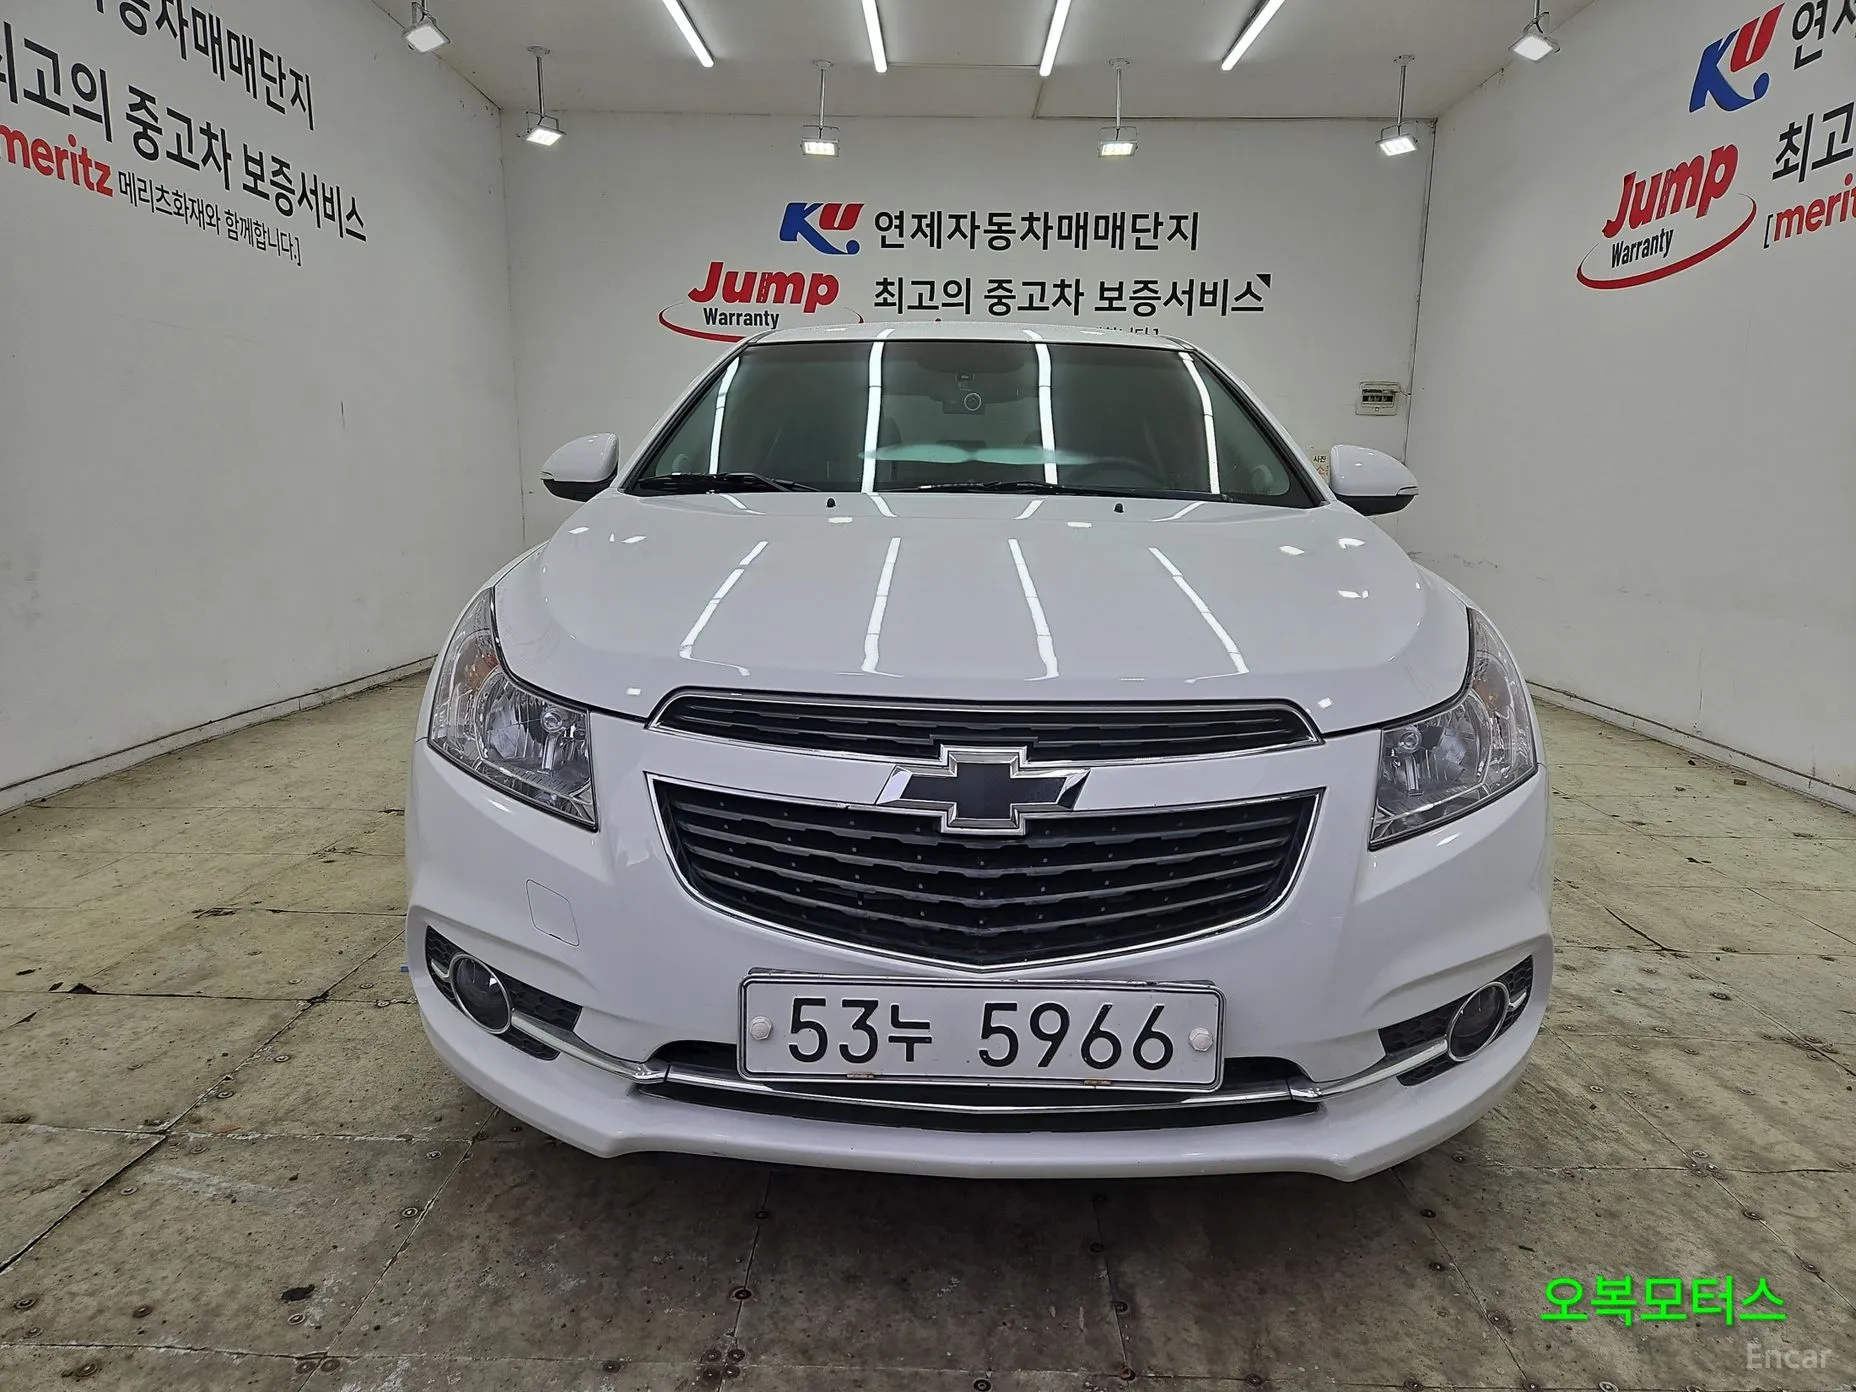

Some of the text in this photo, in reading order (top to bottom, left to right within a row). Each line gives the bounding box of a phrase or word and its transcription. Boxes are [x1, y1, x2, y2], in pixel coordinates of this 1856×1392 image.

[126, 84, 232, 190] 중고차
[242, 143, 367, 242] 보증서비스
[118, 171, 221, 235] 메리츠화재와
[1602, 144, 1738, 239] Jump
[874, 210, 1199, 251] 연제자동차매매단지
[1611, 228, 1674, 268] Warranty
[687, 261, 839, 314] Jump
[873, 277, 1264, 316] 최고의 중고차 보증서비스
[703, 308, 780, 329] Warranty
[788, 997, 1174, 1071] 53누 5966
